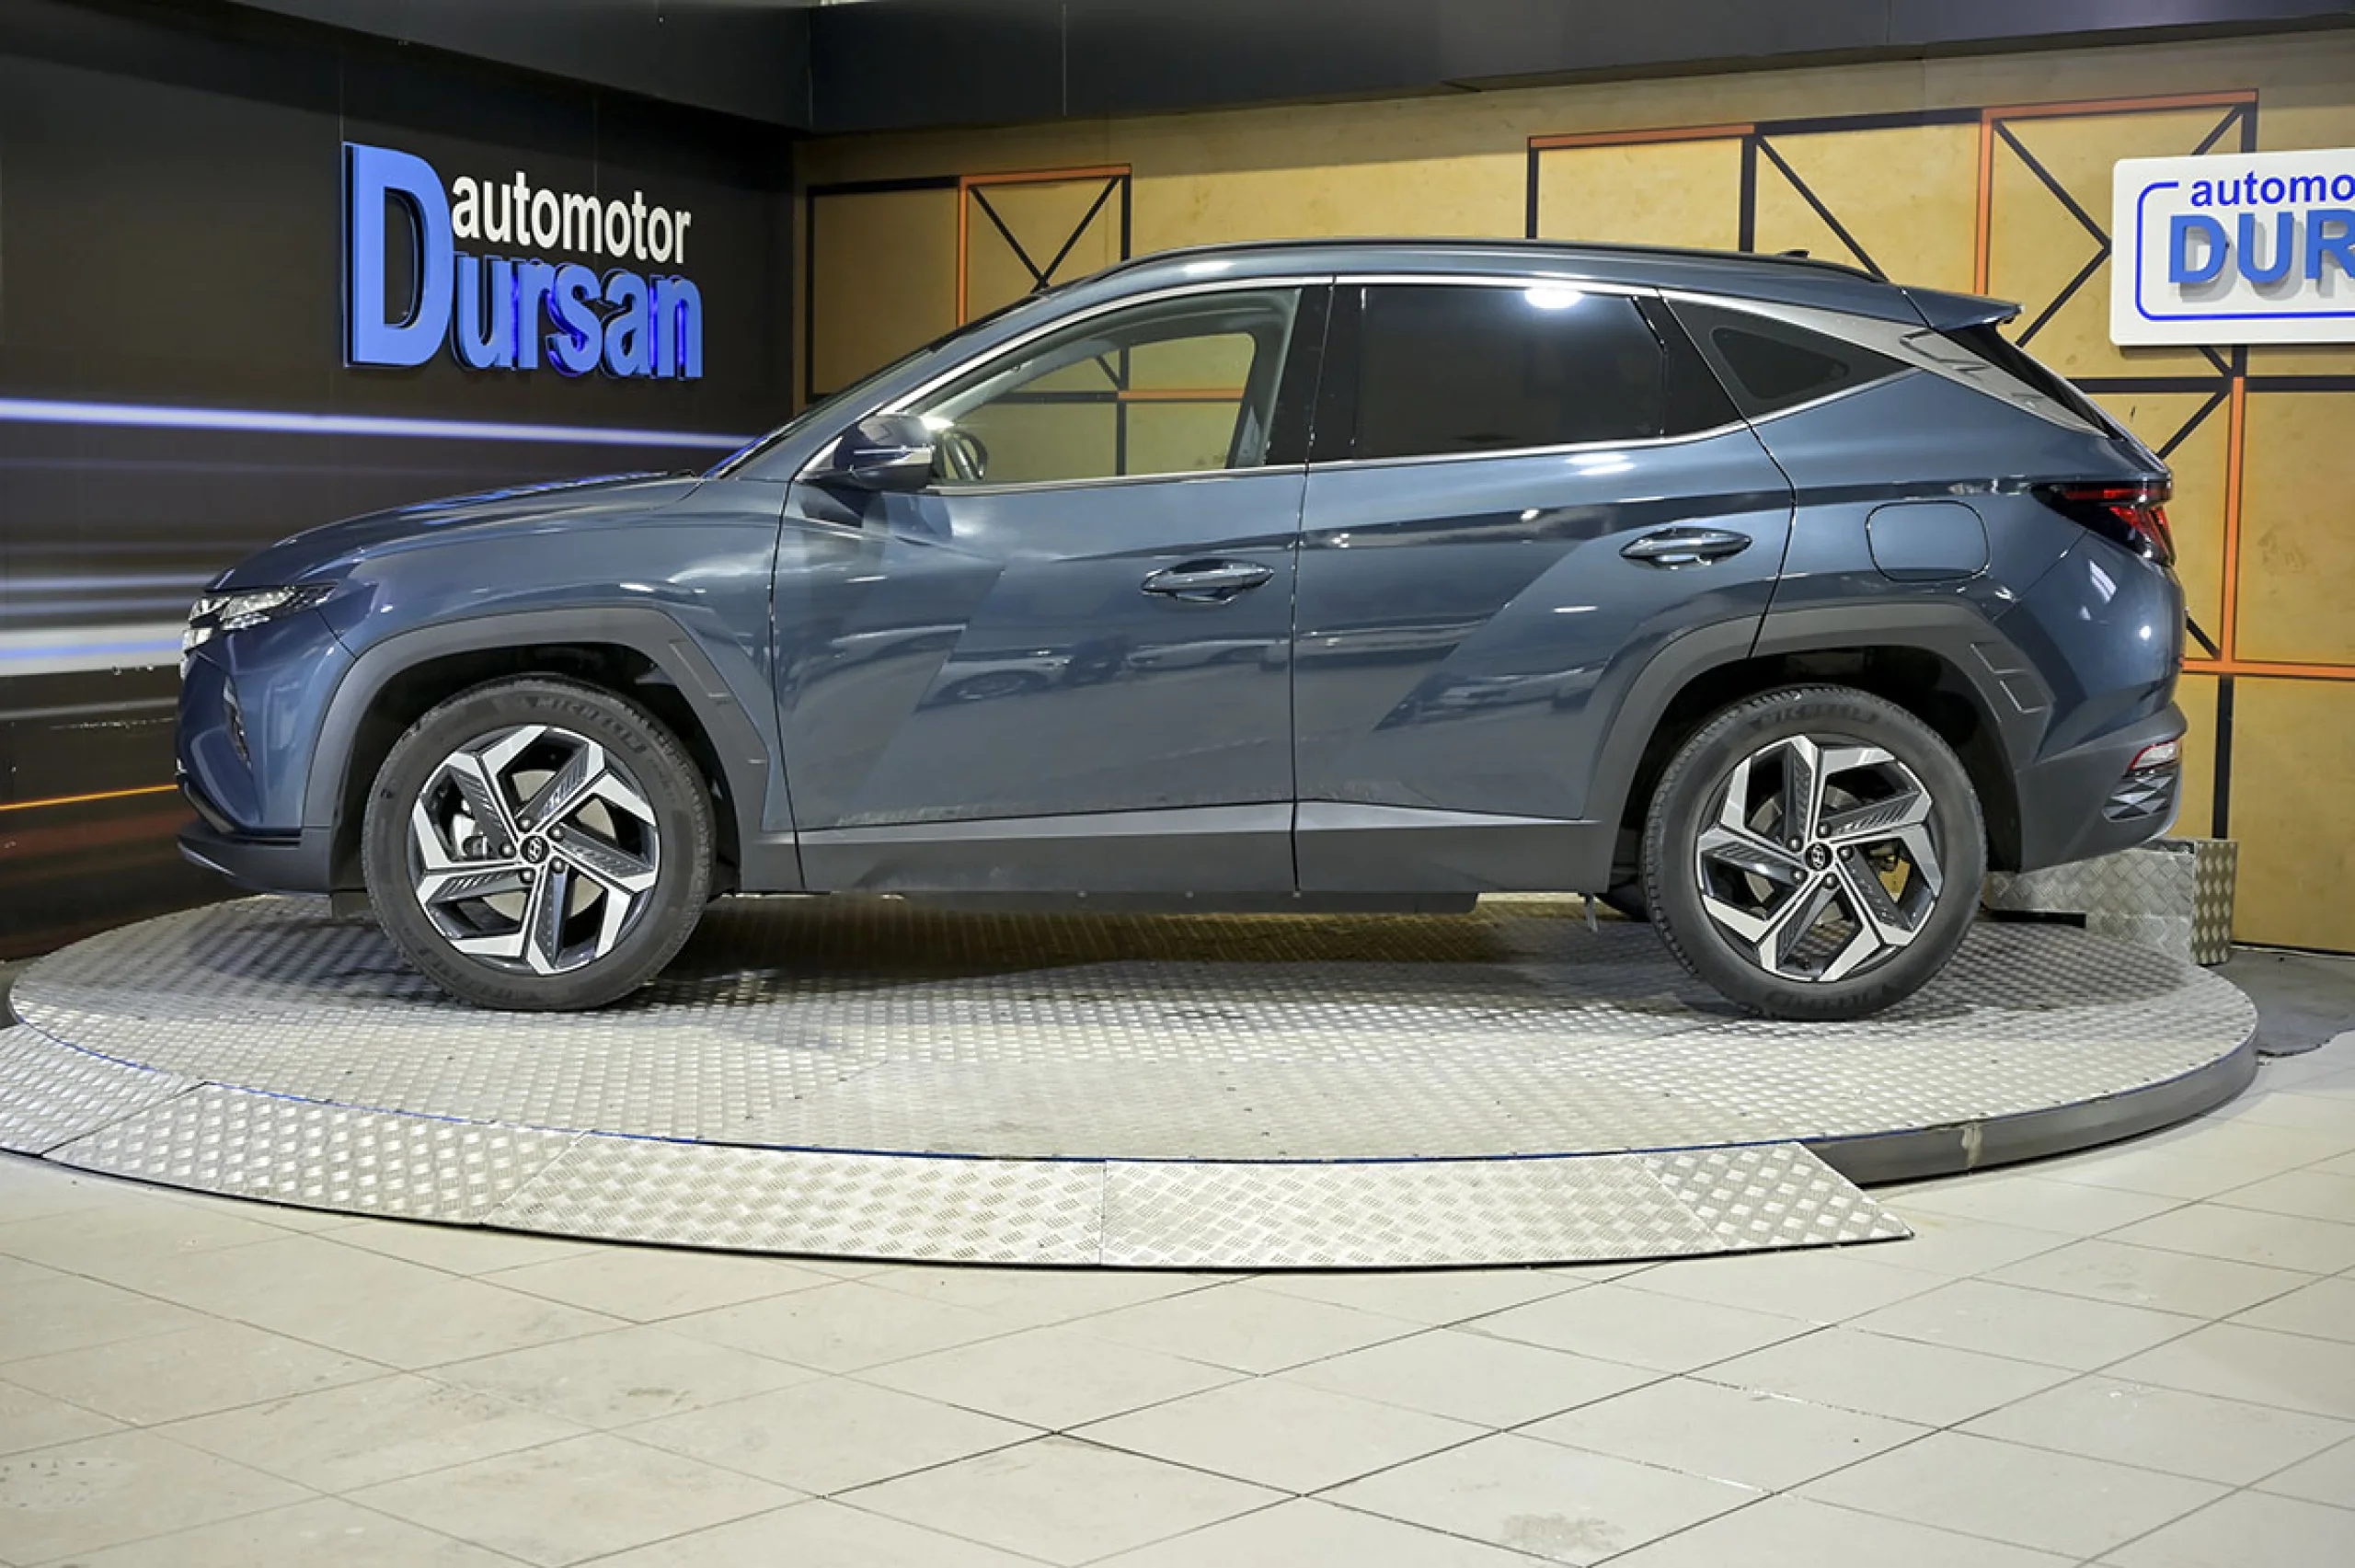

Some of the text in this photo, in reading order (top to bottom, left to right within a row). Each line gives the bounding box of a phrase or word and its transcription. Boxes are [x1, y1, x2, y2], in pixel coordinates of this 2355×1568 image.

[342, 141, 703, 379] Dursan
[451, 171, 691, 263] automotor
[2168, 209, 2355, 283] DUR
